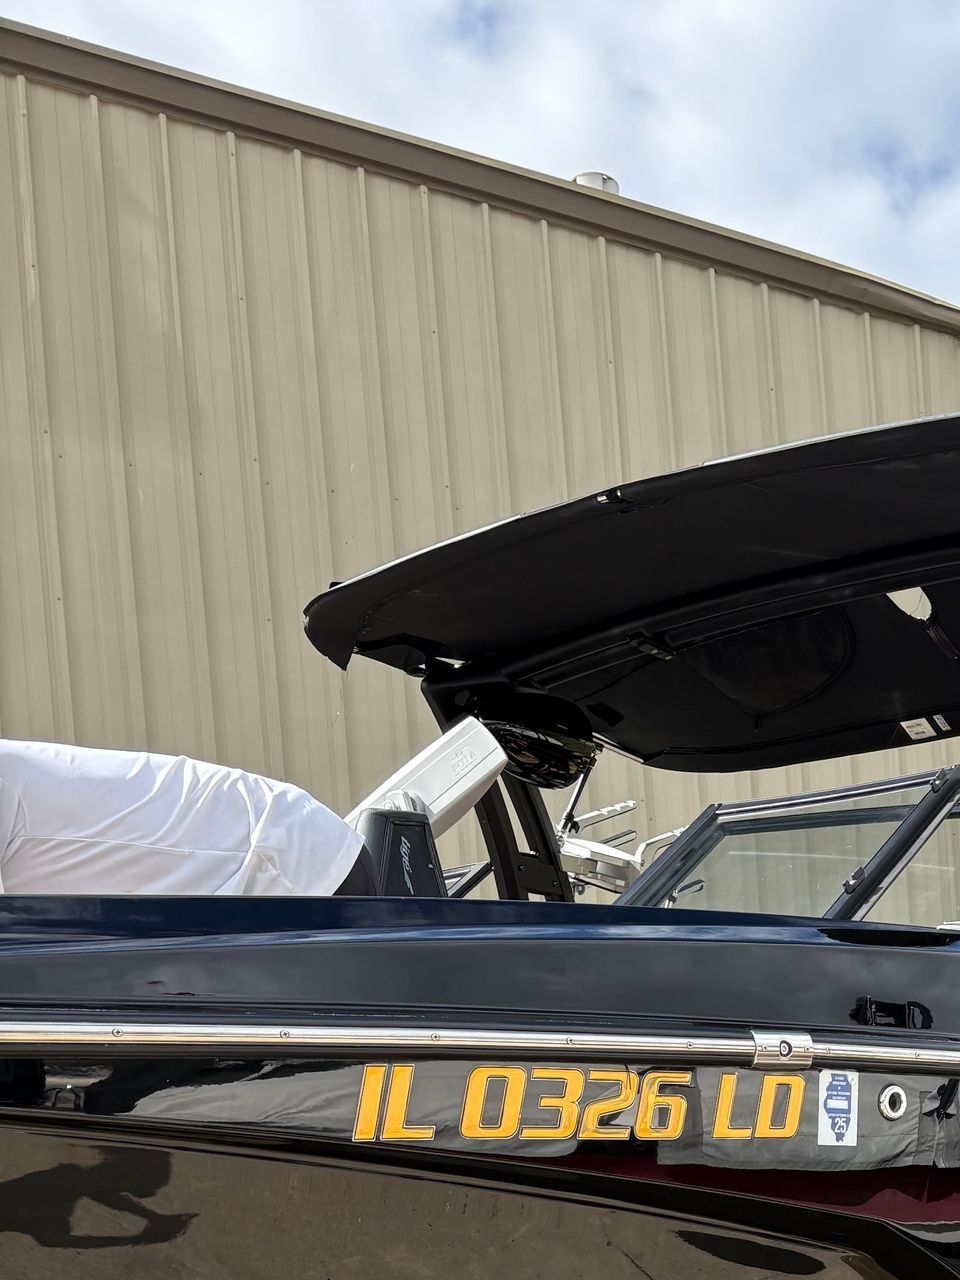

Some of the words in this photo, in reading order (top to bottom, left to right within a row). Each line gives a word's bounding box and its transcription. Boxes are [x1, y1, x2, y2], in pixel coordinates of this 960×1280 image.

[352, 1063, 436, 1142] IL
[459, 1065, 692, 1140] 0326
[712, 1071, 806, 1140] LD
[834, 1117, 847, 1133] 25
